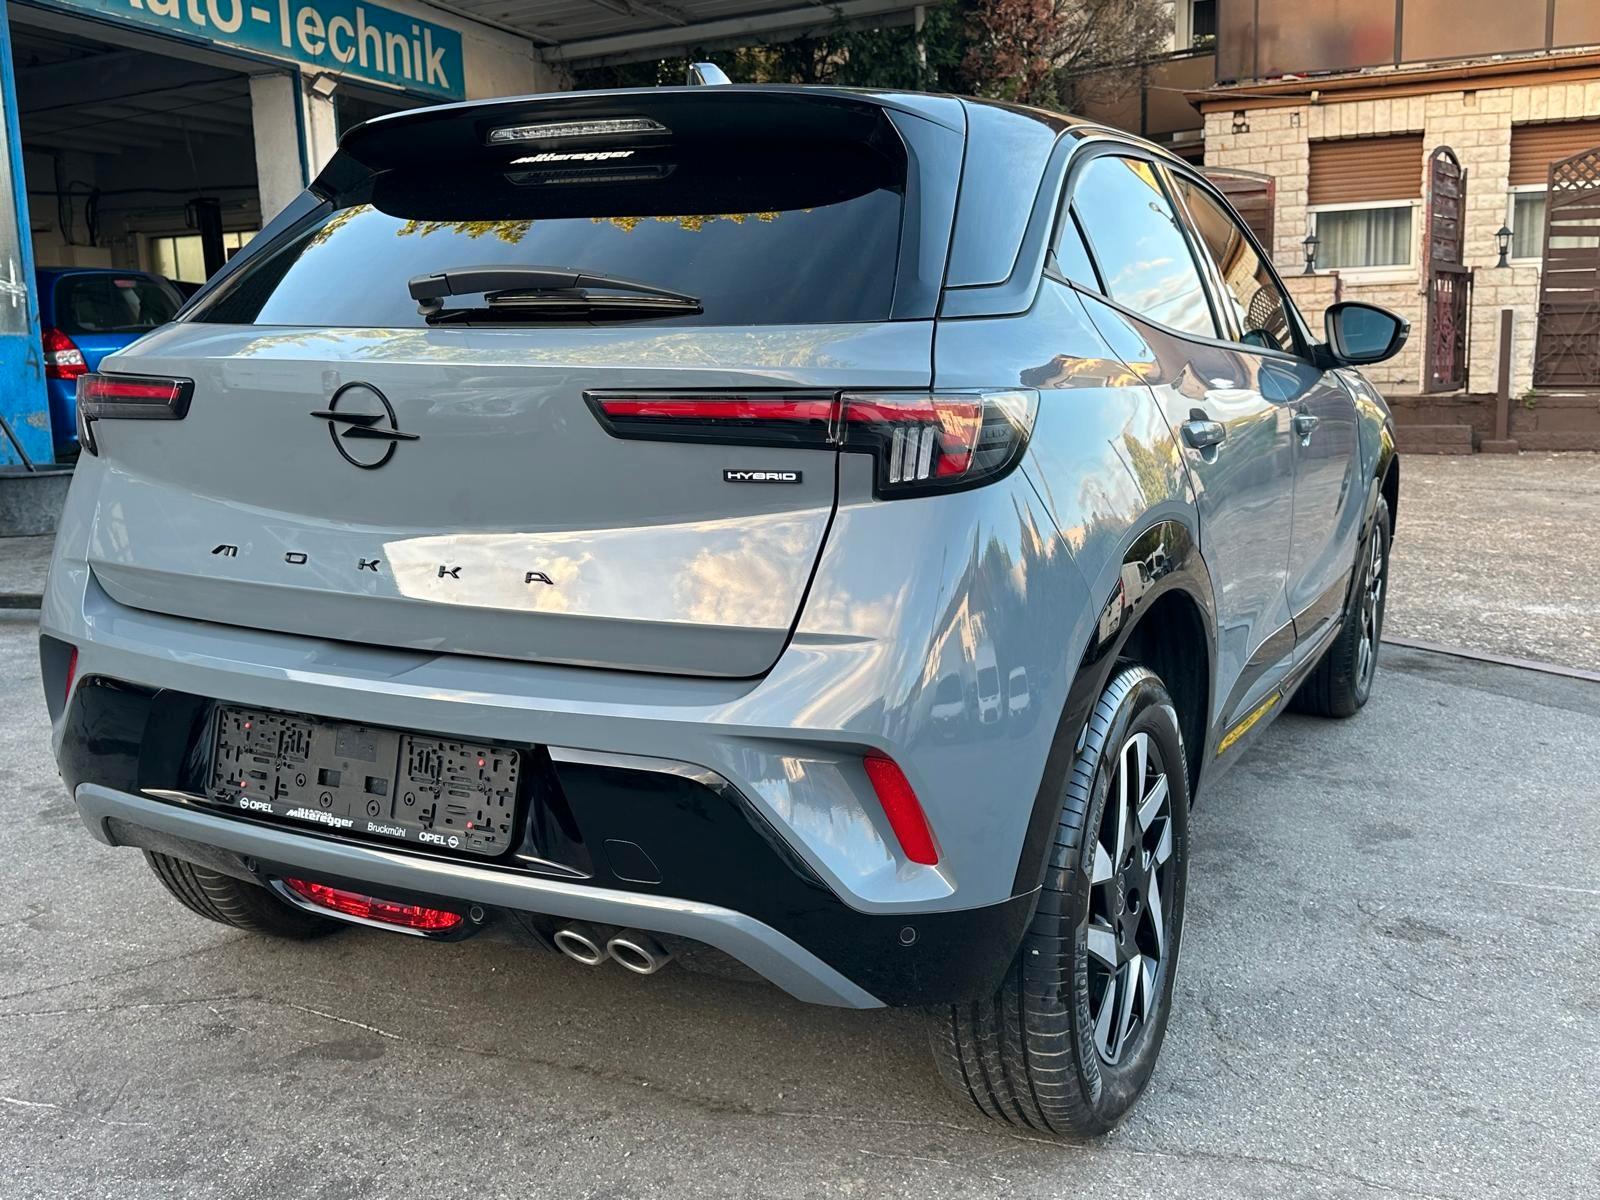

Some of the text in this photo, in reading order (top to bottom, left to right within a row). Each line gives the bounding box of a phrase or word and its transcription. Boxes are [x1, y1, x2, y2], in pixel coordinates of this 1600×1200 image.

[129, 0, 450, 88] o-Technik
[509, 151, 635, 164] mitteregger
[727, 471, 797, 481] HYBRID
[210, 543, 554, 586] MOKKA
[249, 800, 274, 813] OPEL
[286, 807, 407, 838] mitteregger Bruckmühl
[418, 832, 447, 845] OPEL
